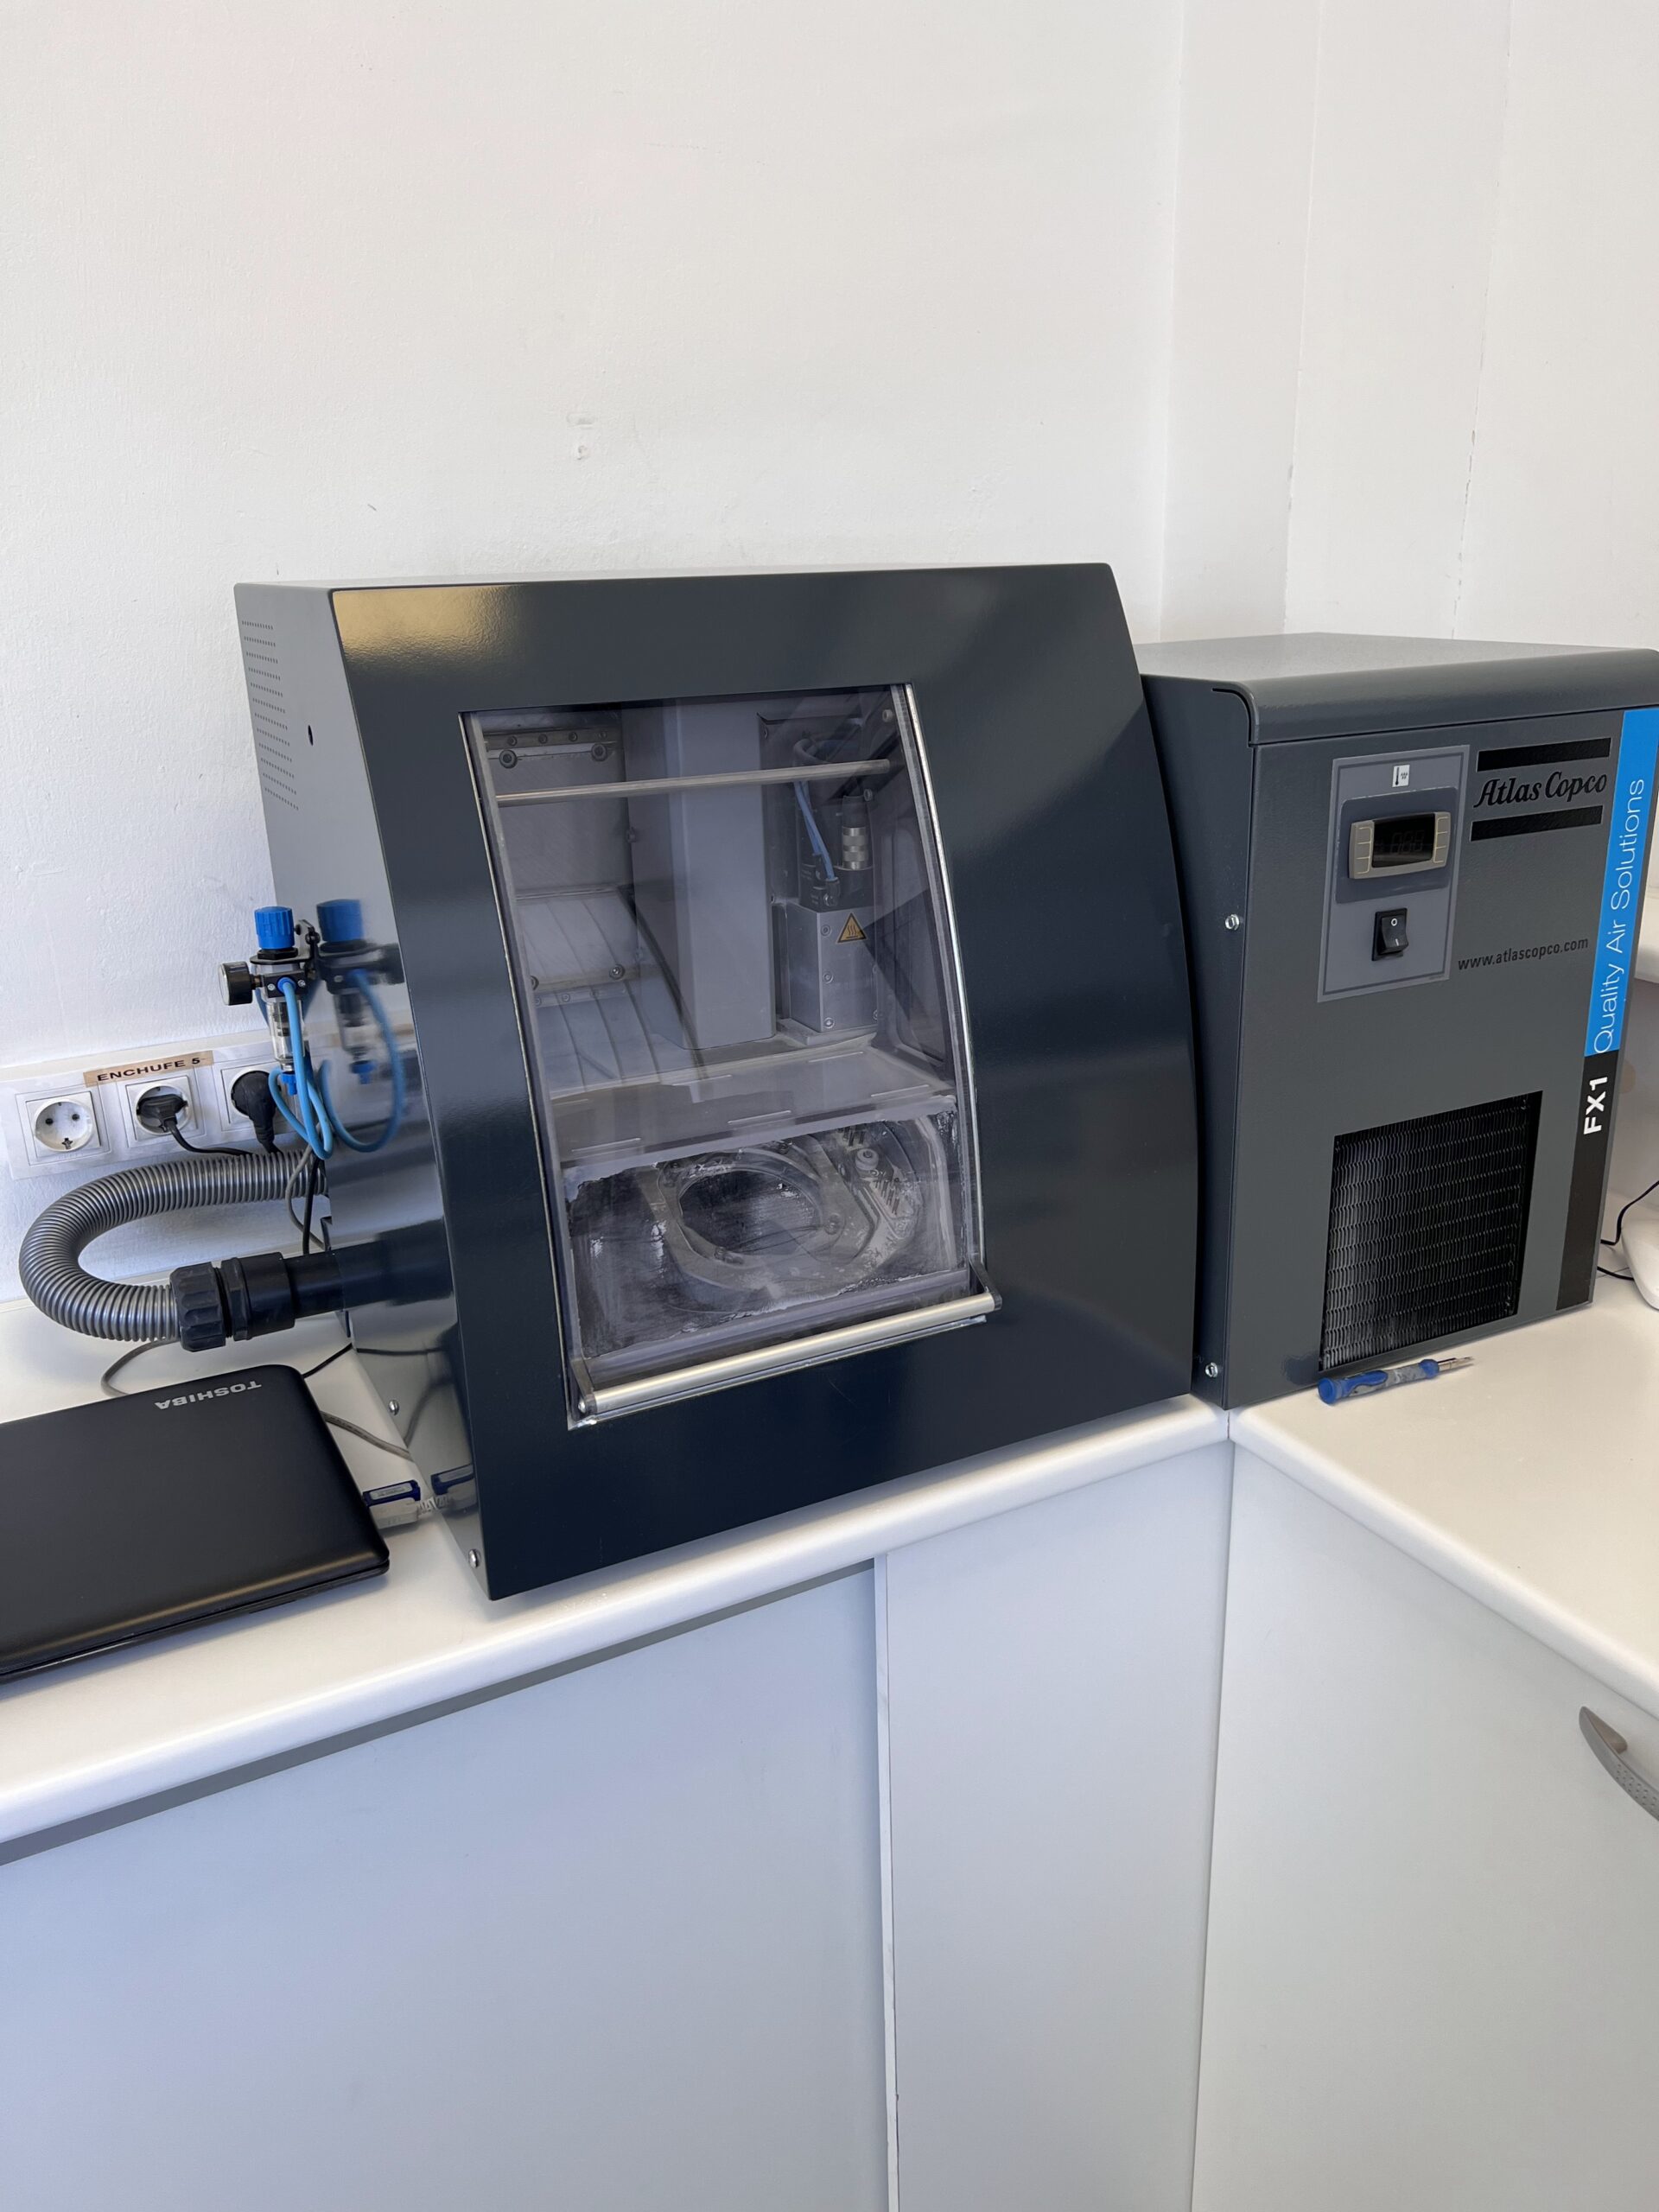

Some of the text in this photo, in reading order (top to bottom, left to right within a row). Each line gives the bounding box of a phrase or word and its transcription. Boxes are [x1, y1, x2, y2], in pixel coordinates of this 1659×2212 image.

[1473, 772, 1607, 808] Atlas Copco
[1594, 779, 1644, 1053] Quality Air Solutions
[1458, 938, 1588, 970] www.atlascopco.com
[97, 1060, 186, 1081] ENCHUFE
[1583, 1077, 1608, 1135] FX1
[155, 1381, 262, 1409] TOSHIBA
